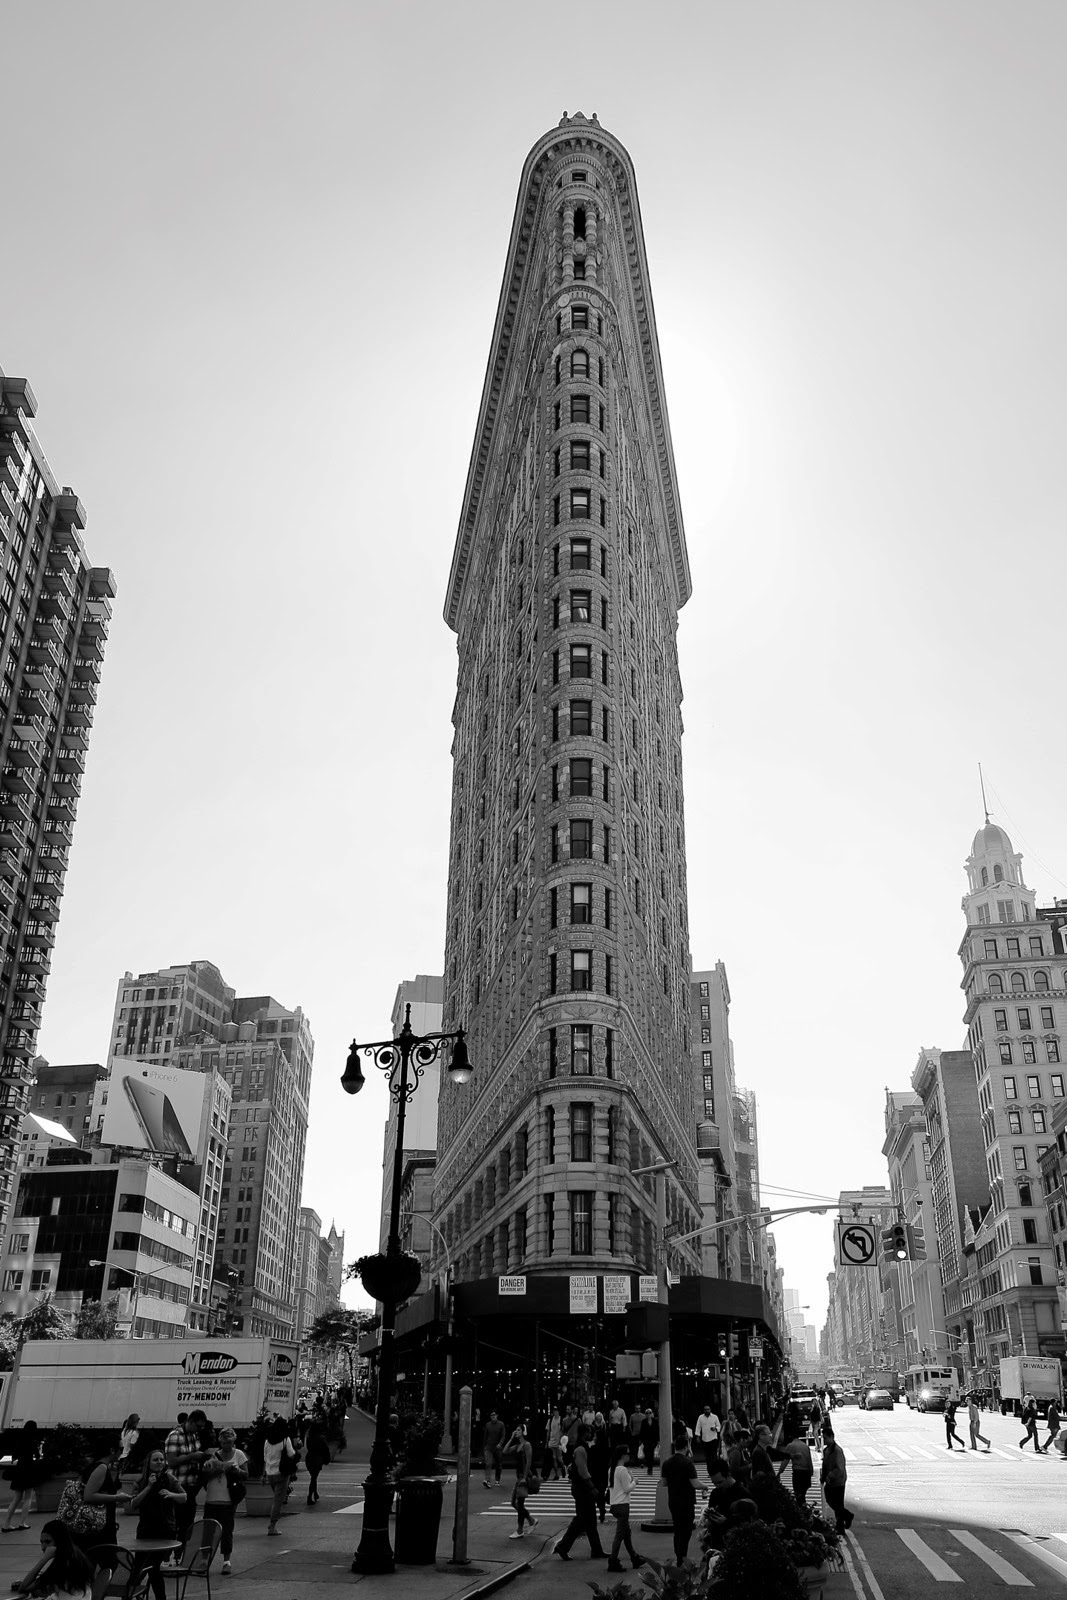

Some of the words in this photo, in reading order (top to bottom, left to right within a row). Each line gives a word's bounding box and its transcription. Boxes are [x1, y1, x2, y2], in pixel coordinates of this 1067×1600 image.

[150, 1071, 172, 1082] iPhone
[173, 1075, 178, 1083] 6
[501, 1279, 525, 1288] DANGER
[571, 1277, 596, 1288] SKYLINE
[184, 1352, 235, 1375] Mendon
[269, 1353, 292, 1375] Mendon
[178, 1392, 231, 1401] 877-MENDON1
